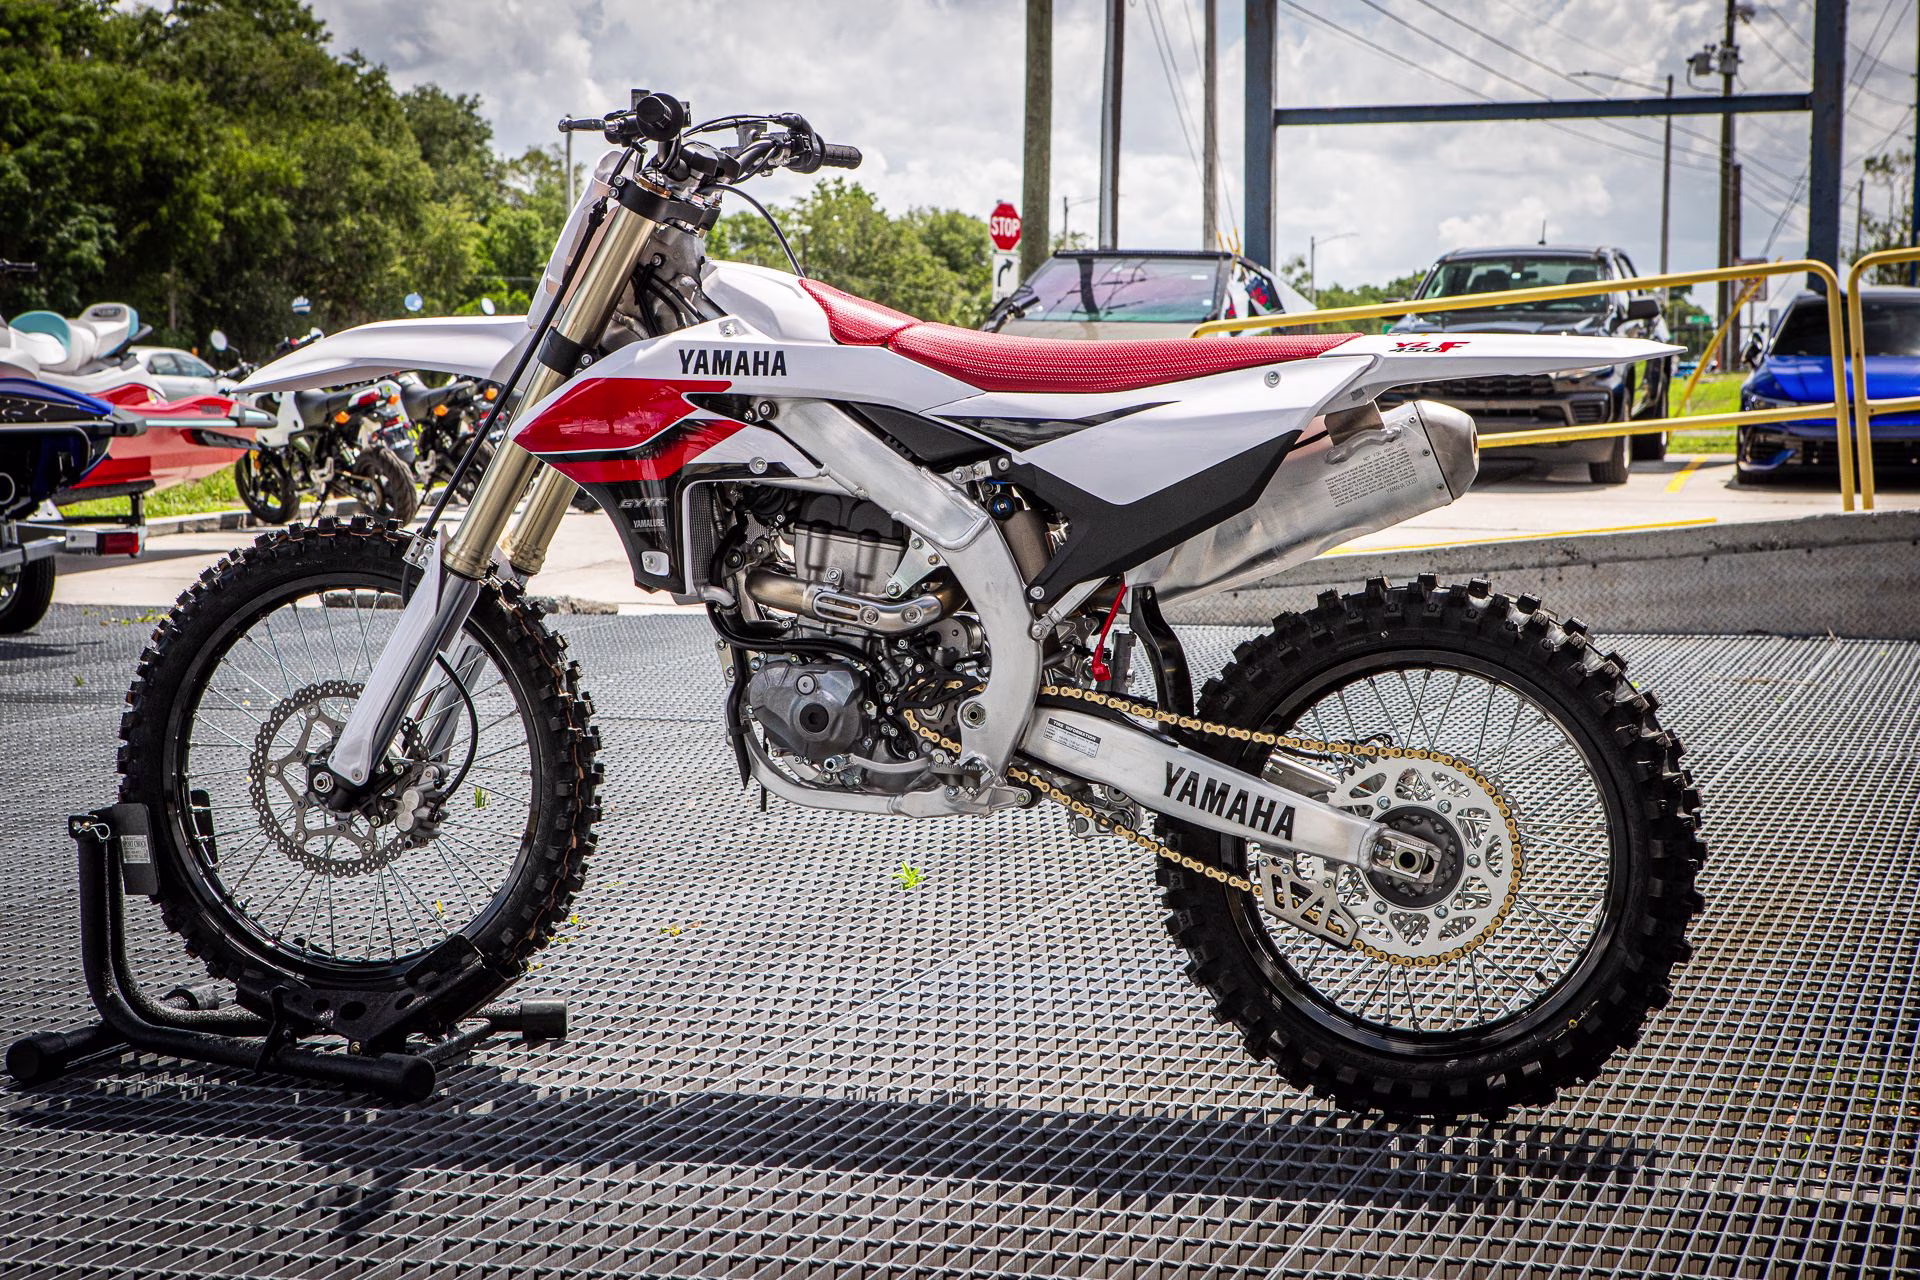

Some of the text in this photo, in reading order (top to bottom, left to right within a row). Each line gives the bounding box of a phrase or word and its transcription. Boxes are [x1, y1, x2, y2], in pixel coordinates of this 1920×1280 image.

[991, 216, 1020, 238] STOP
[678, 349, 788, 376] YAMAHA
[619, 497, 669, 508] GYTR
[633, 518, 665, 528] YAMALUBE
[1053, 720, 1064, 729] TIRE
[1065, 724, 1097, 742] INFORMATION
[1163, 761, 1296, 841] YAMAHA
